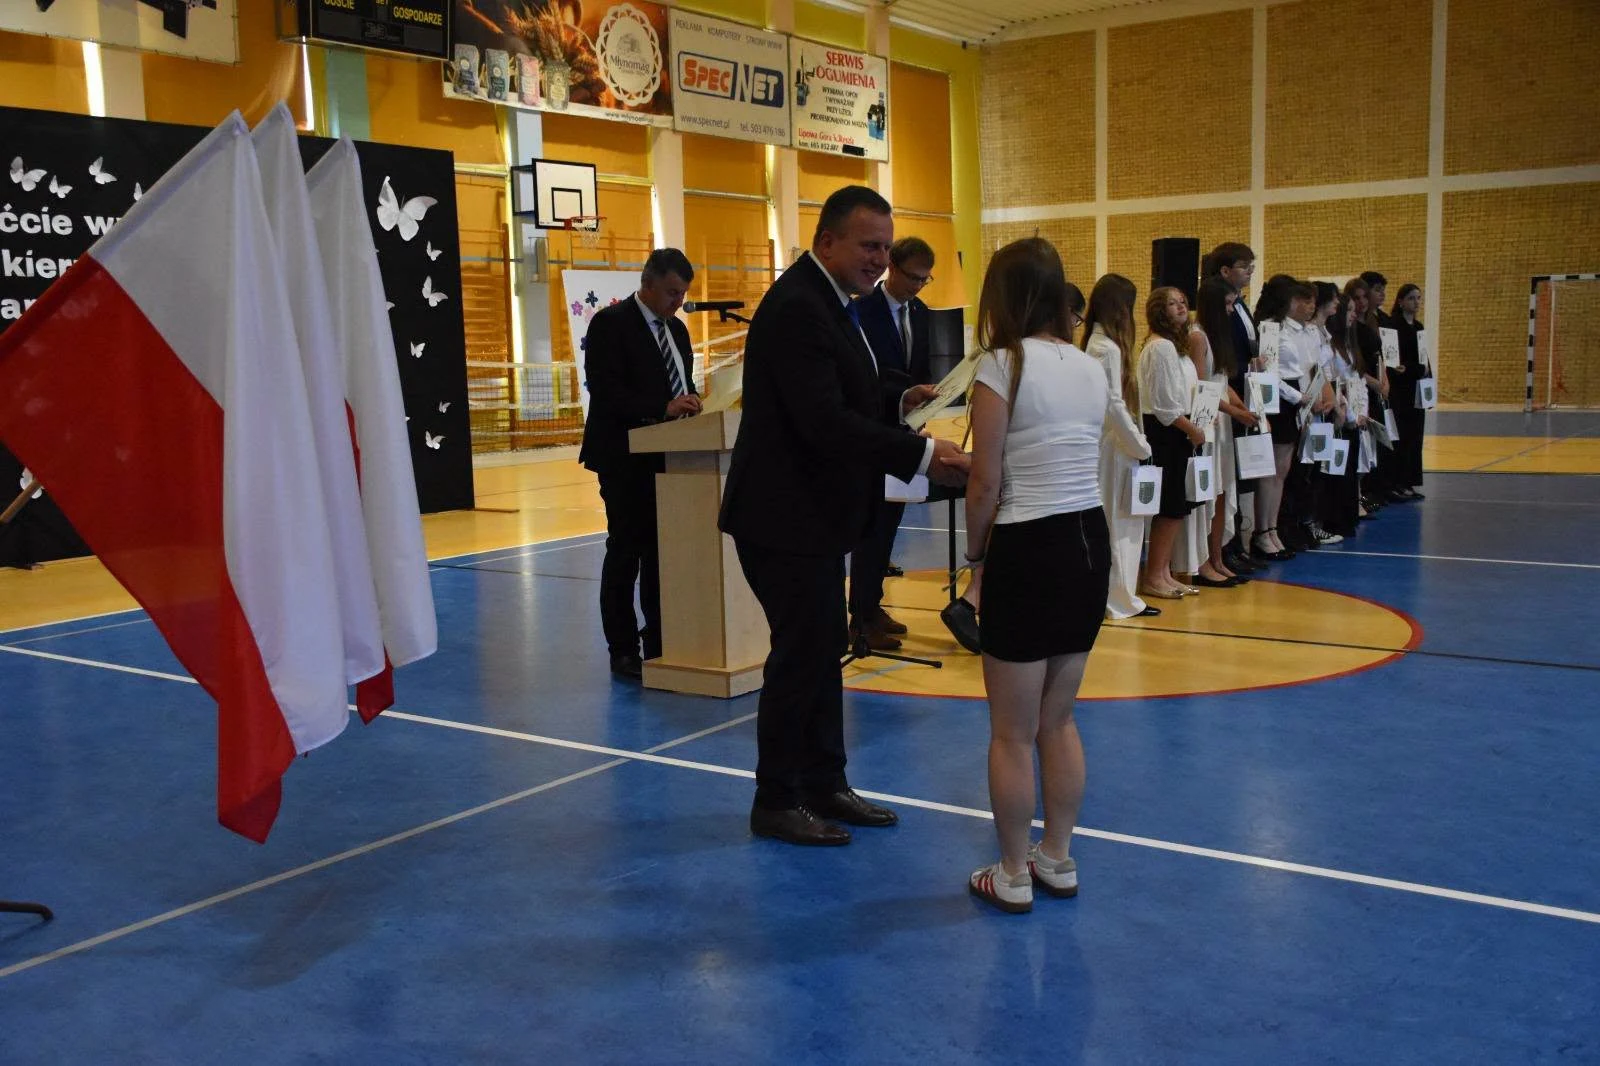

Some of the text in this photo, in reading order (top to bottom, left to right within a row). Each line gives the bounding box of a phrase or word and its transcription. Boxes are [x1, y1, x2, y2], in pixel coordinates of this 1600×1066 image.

[393, 6, 443, 26] GOSPODARZE
[675, 19, 703, 33] REKLAMA
[708, 27, 741, 41] KOMPUTERY
[826, 51, 864, 69] SERWIS
[815, 65, 876, 90] OGUMIENIA
[680, 114, 730, 129] www.specnet.pl
[750, 123, 762, 134] 503
[84, 215, 121, 236] w
[1, 248, 78, 279] kier
